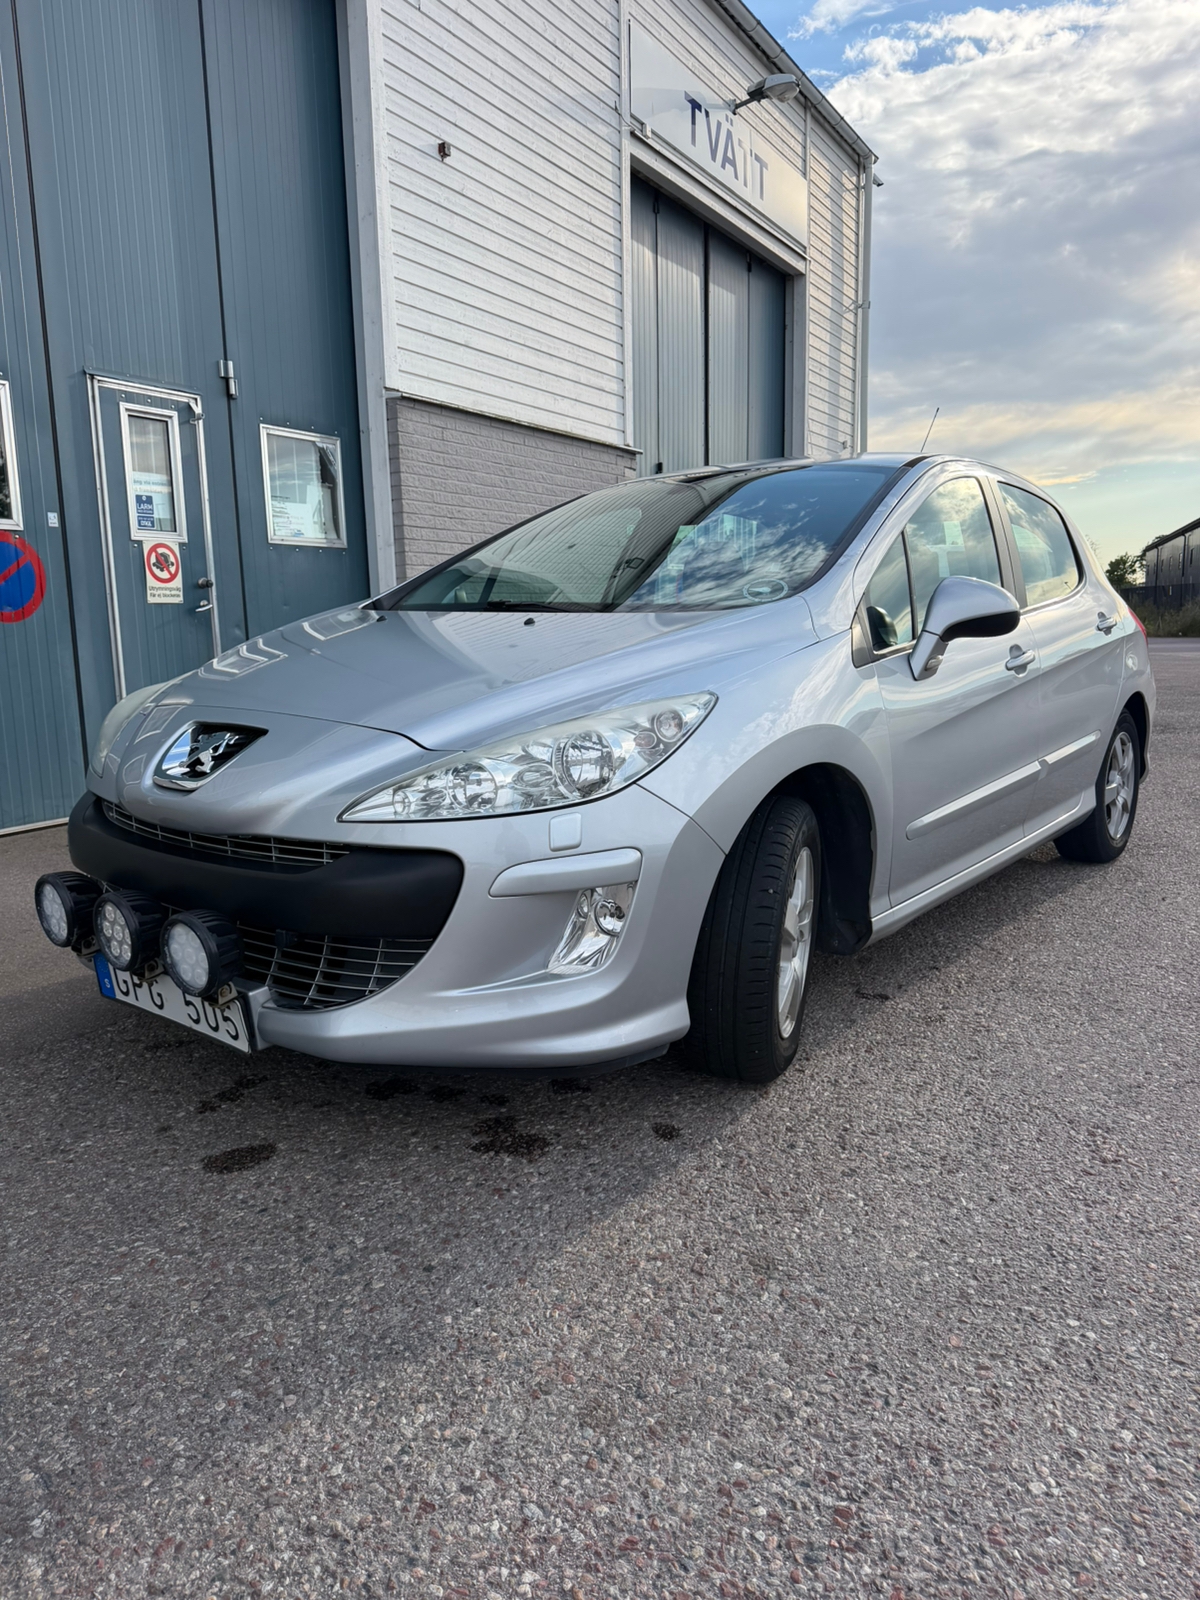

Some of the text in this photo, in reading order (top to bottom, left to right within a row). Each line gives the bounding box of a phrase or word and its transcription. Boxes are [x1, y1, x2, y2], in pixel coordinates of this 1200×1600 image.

[684, 90, 769, 201] TVÄTT
[136, 502, 153, 510] LARM
[148, 585, 182, 593] Utrymningsväg
[104, 978, 110, 989] S
